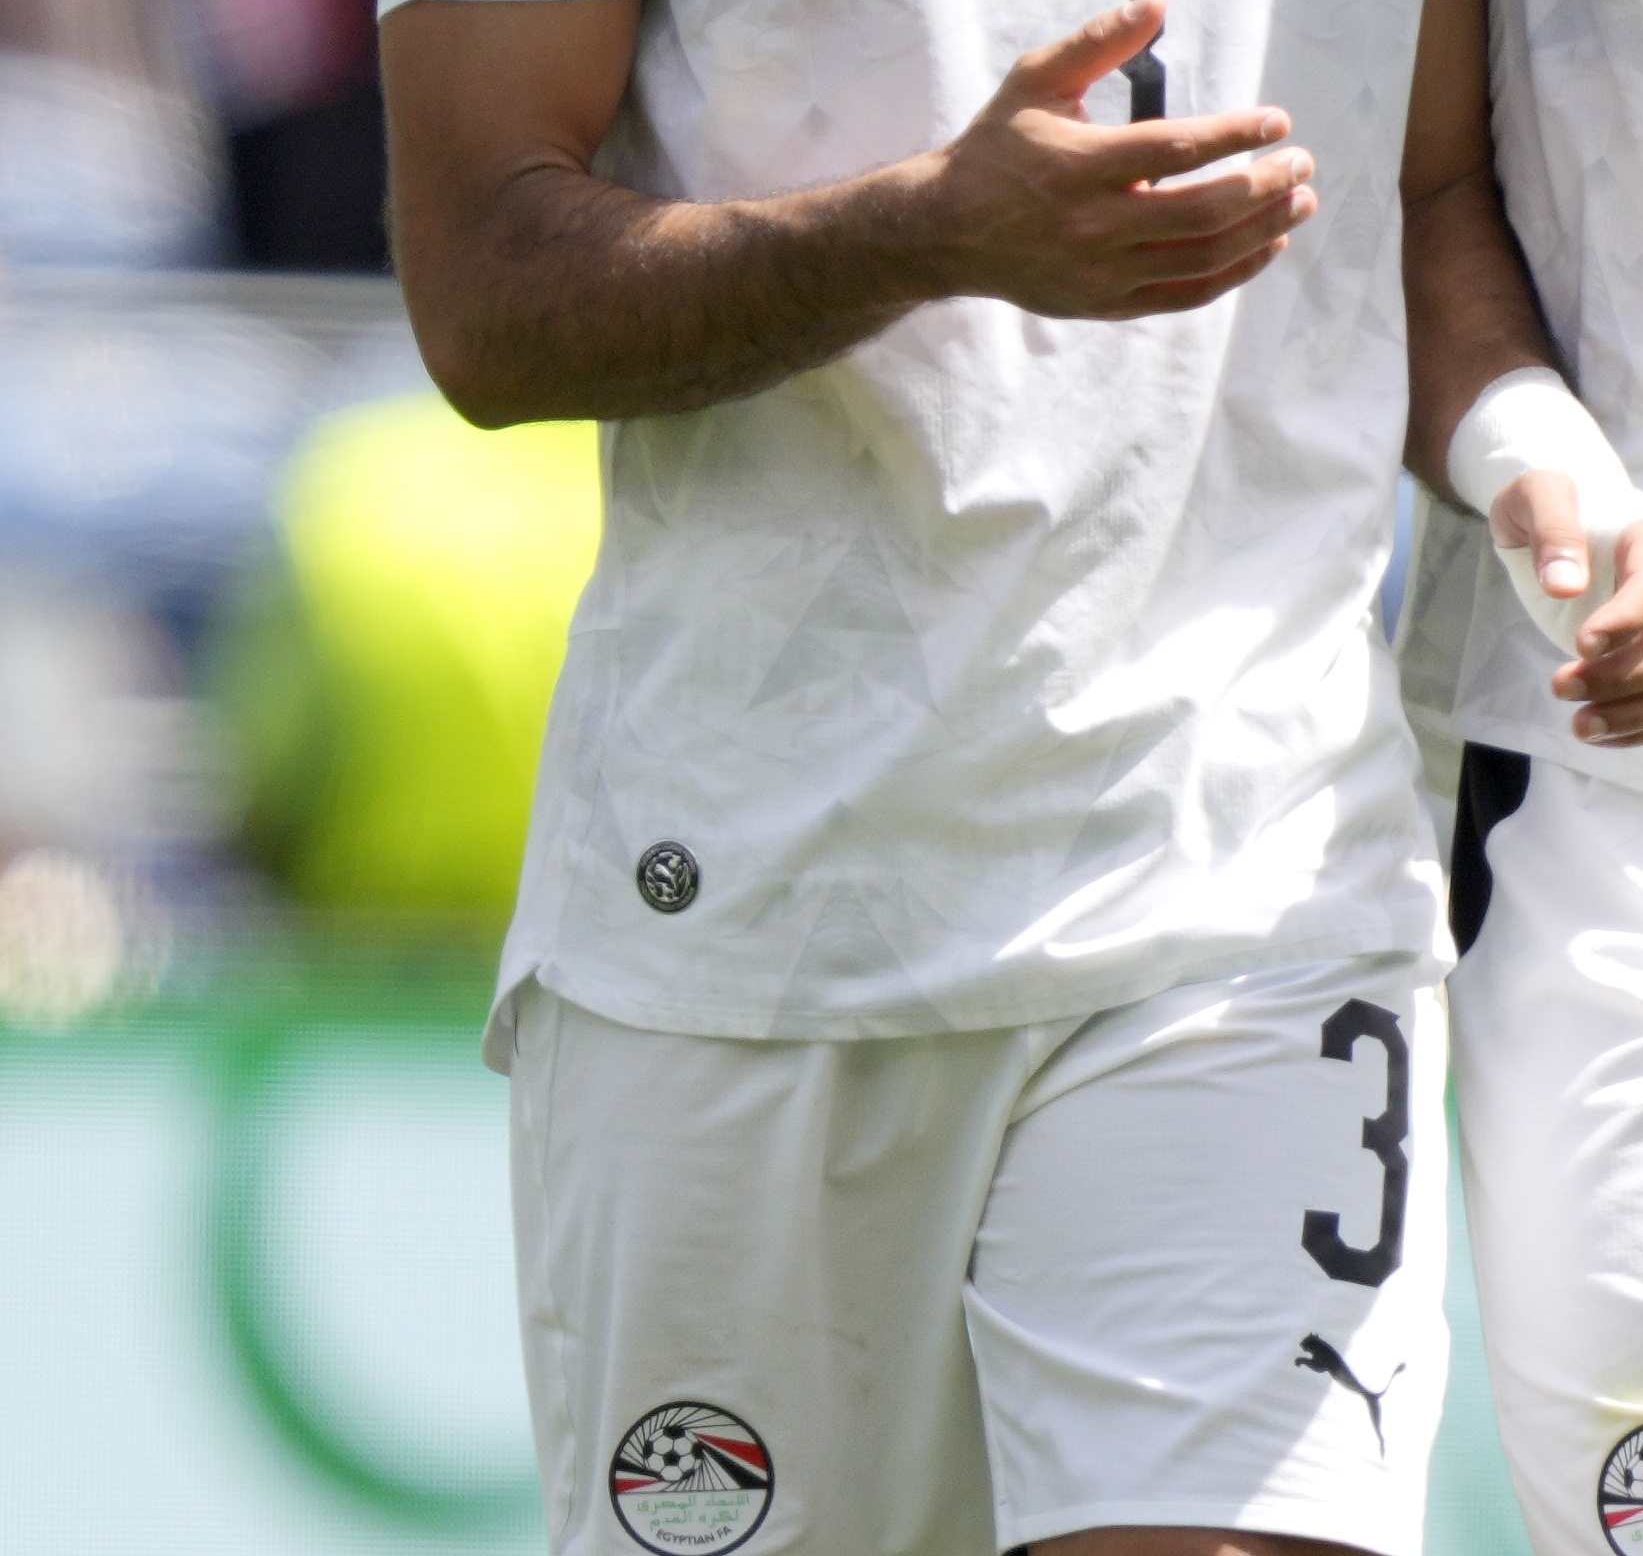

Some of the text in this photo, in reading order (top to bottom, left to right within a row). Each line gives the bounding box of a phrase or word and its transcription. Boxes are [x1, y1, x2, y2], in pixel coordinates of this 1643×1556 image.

[1301, 998, 1409, 1288] 3
[656, 1525, 733, 1547] EGYPTIAN FA
